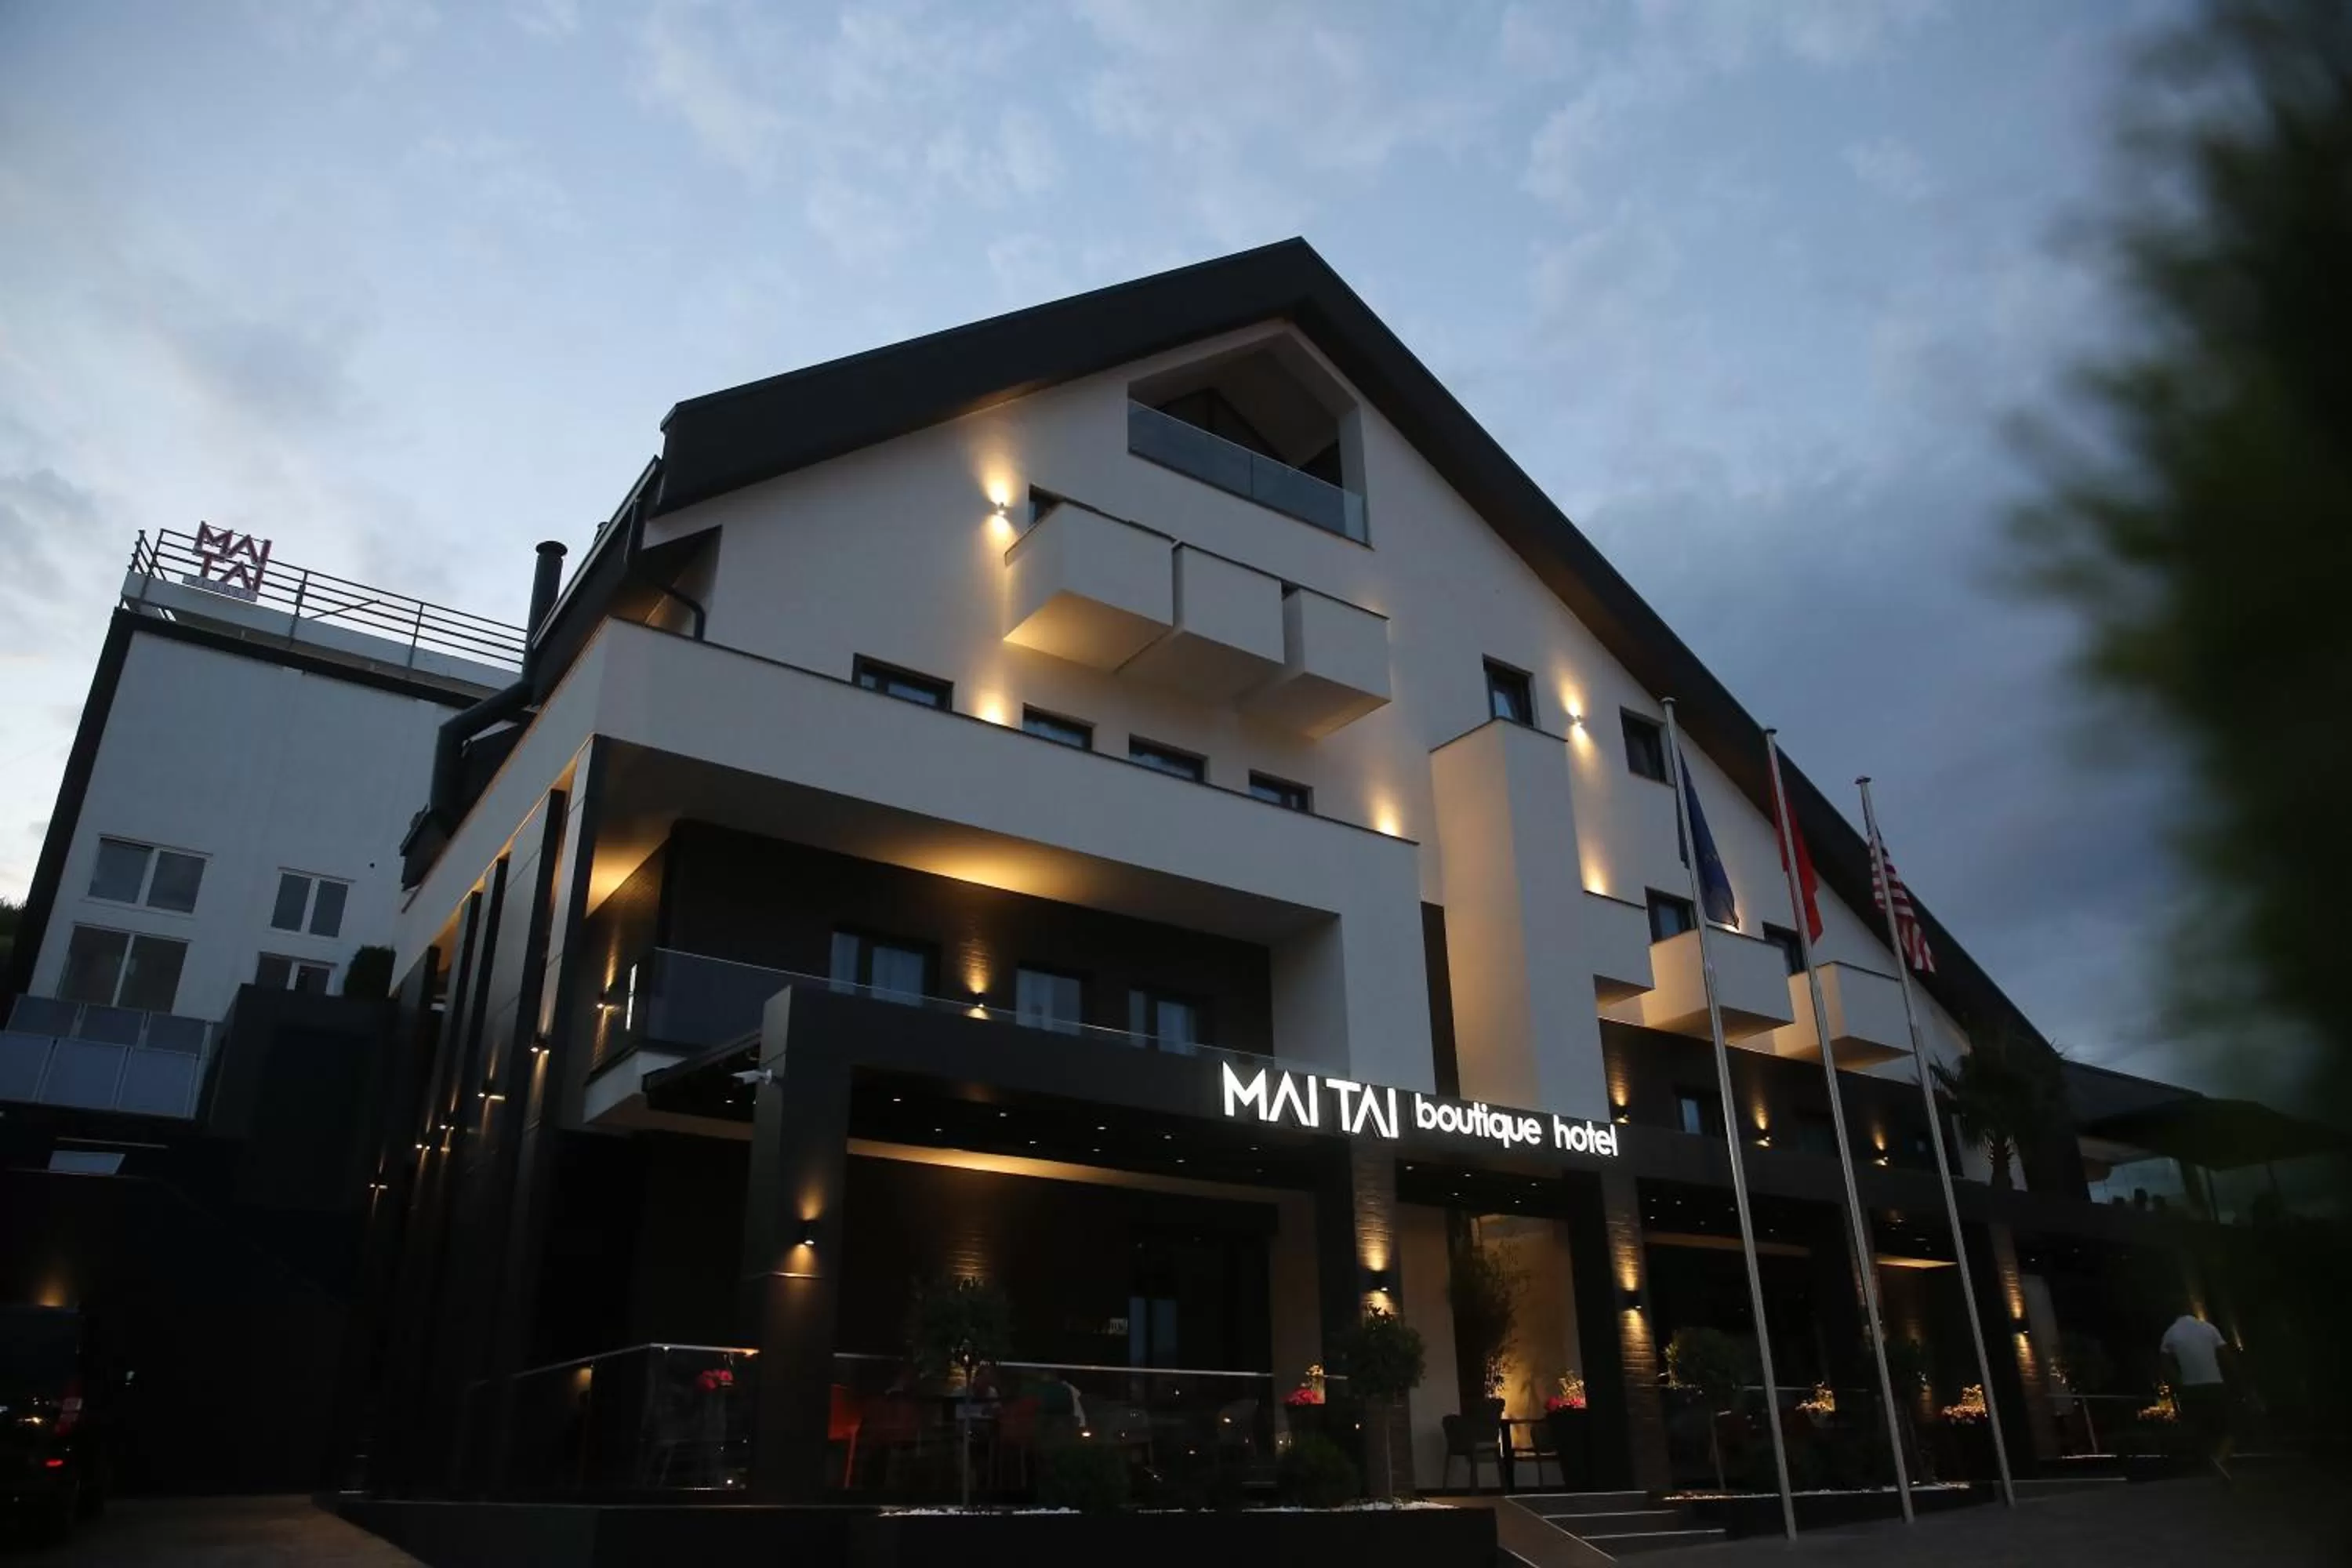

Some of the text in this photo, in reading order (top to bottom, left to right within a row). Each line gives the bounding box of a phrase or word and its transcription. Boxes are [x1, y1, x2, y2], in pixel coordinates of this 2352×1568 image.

[194, 521, 272, 565] MAI
[193, 547, 266, 593] TAI
[1221, 1061, 1619, 1156] MAI TAI boutique hotel
